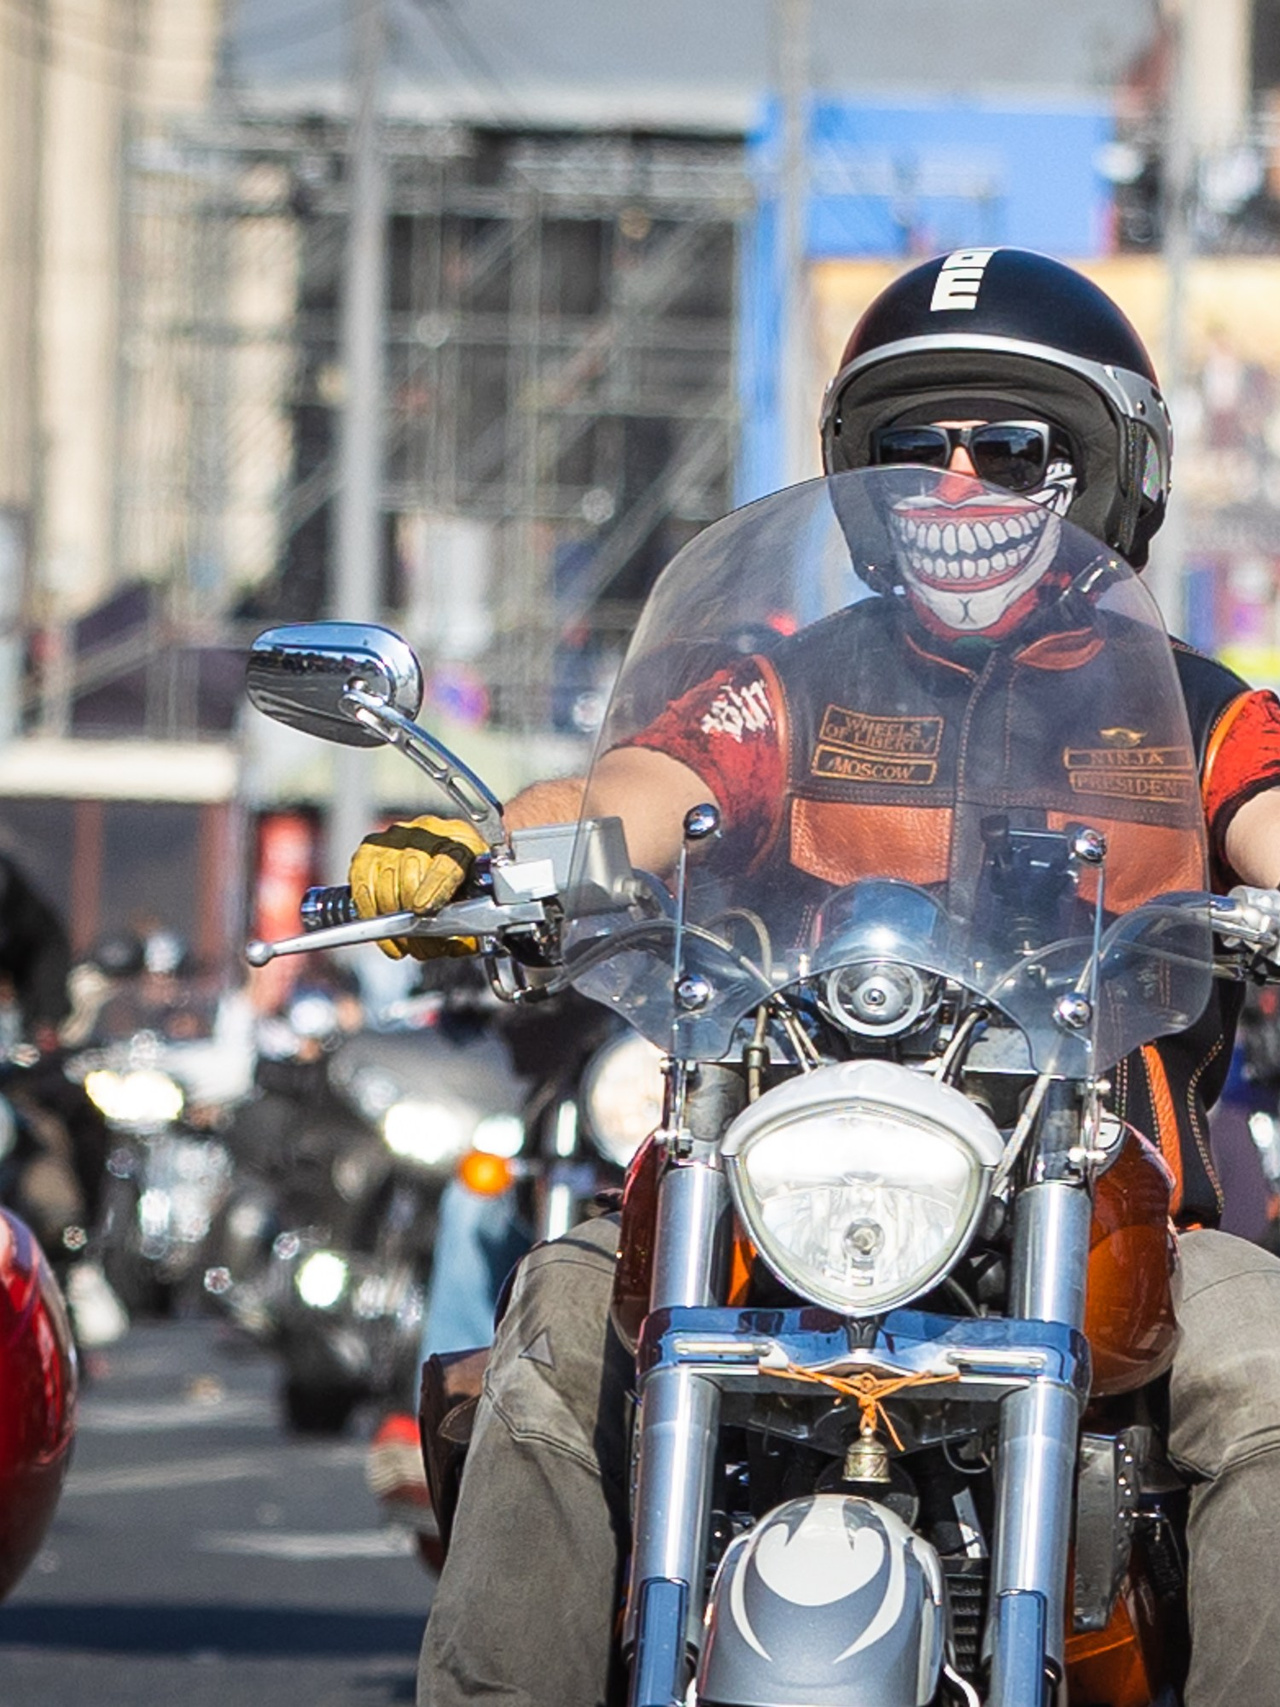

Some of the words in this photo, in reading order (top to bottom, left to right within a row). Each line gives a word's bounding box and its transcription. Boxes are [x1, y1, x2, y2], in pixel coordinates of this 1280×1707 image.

[825, 722, 848, 739] OF
[854, 729, 935, 752] LIBERTY
[845, 715, 922, 738] WHEELS
[827, 756, 915, 780] MOSCOW
[1090, 750, 1164, 766] NINJA
[1077, 773, 1191, 797] PRESIDENT
